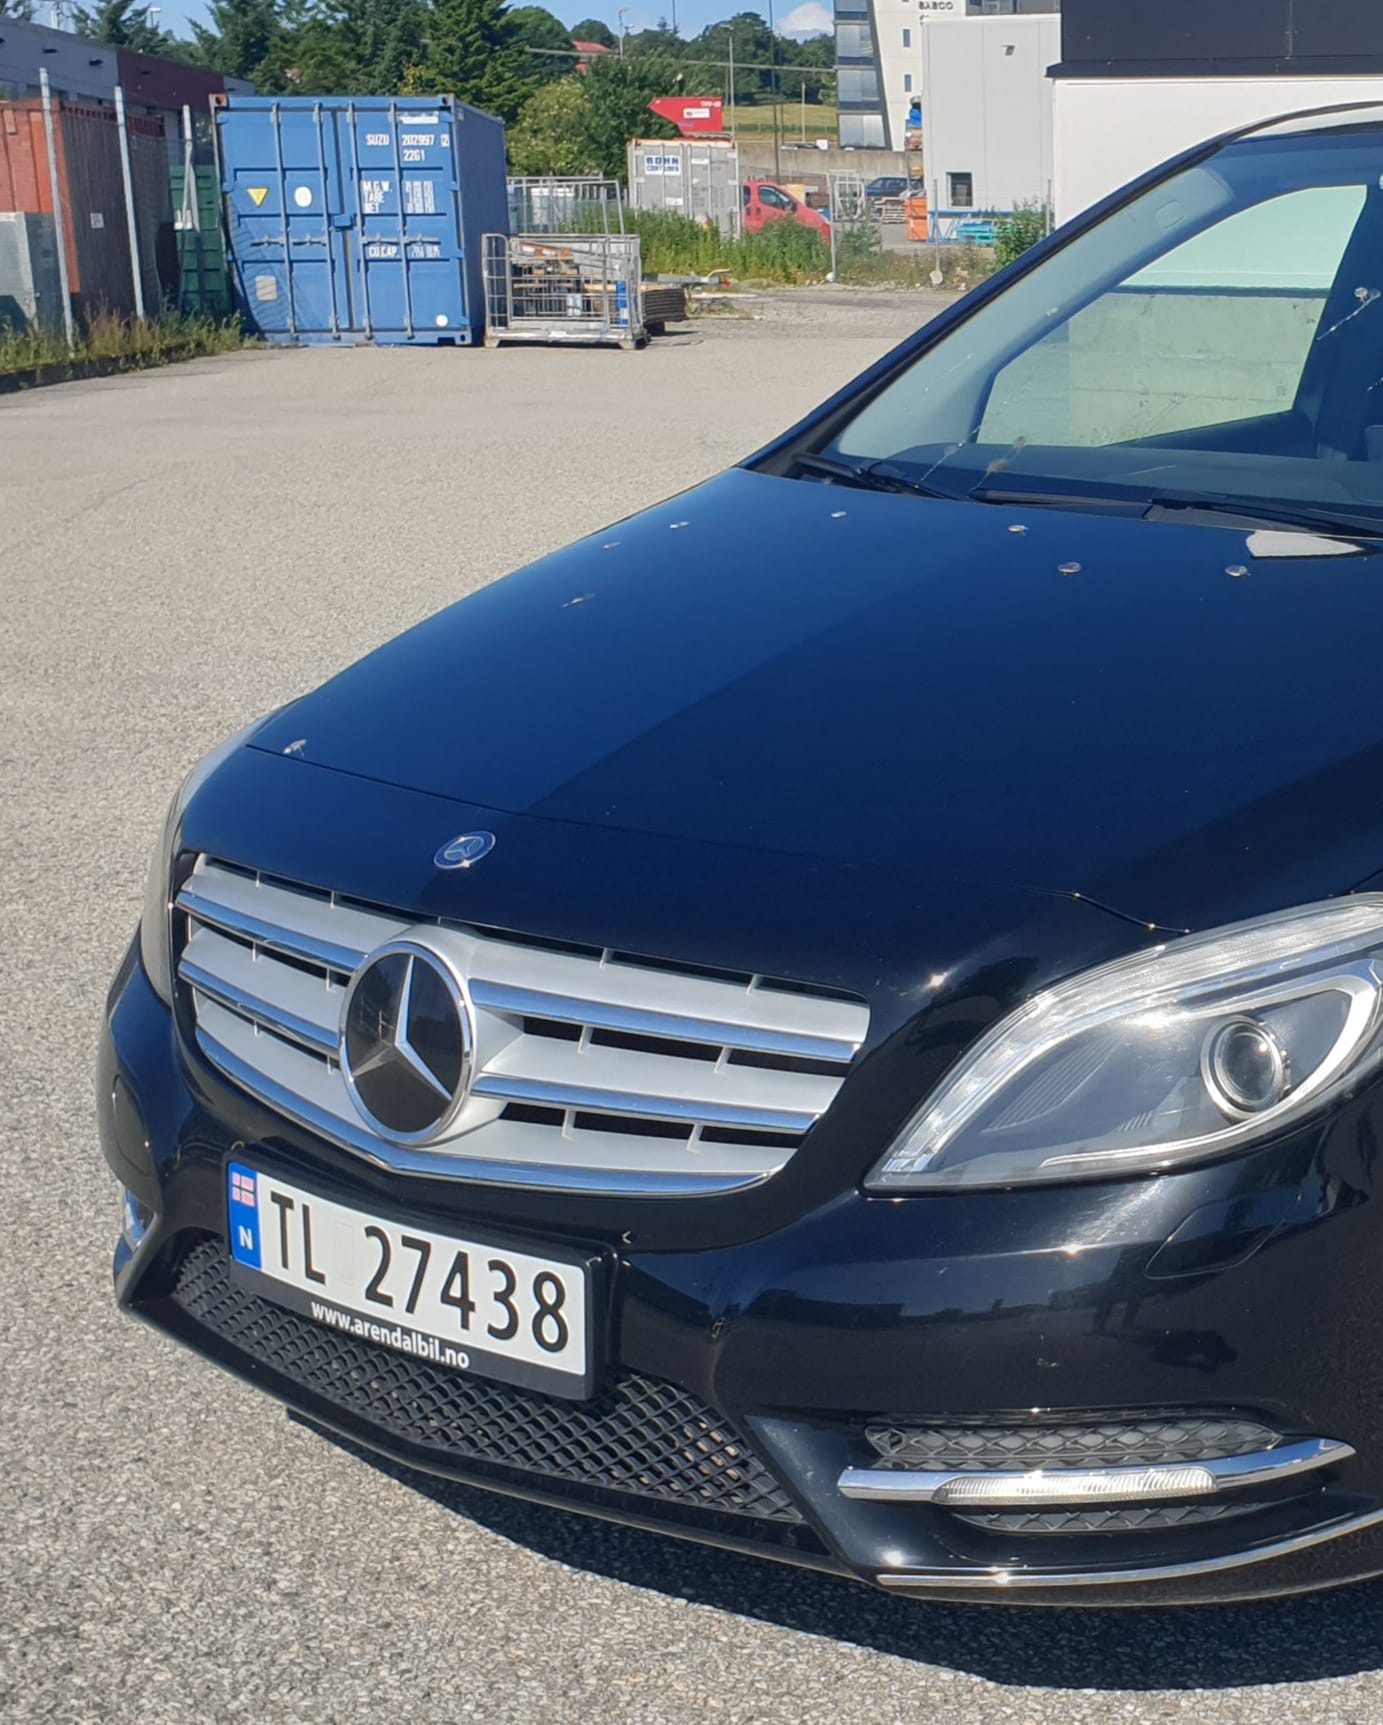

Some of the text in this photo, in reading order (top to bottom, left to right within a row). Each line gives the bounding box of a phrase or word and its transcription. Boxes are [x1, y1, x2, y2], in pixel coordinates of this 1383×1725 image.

[366, 133, 390, 146] SUZU
[238, 1224, 253, 1250] N
[270, 1190, 569, 1353] TL 27438
[310, 1300, 471, 1370] www.arendalbil.no
